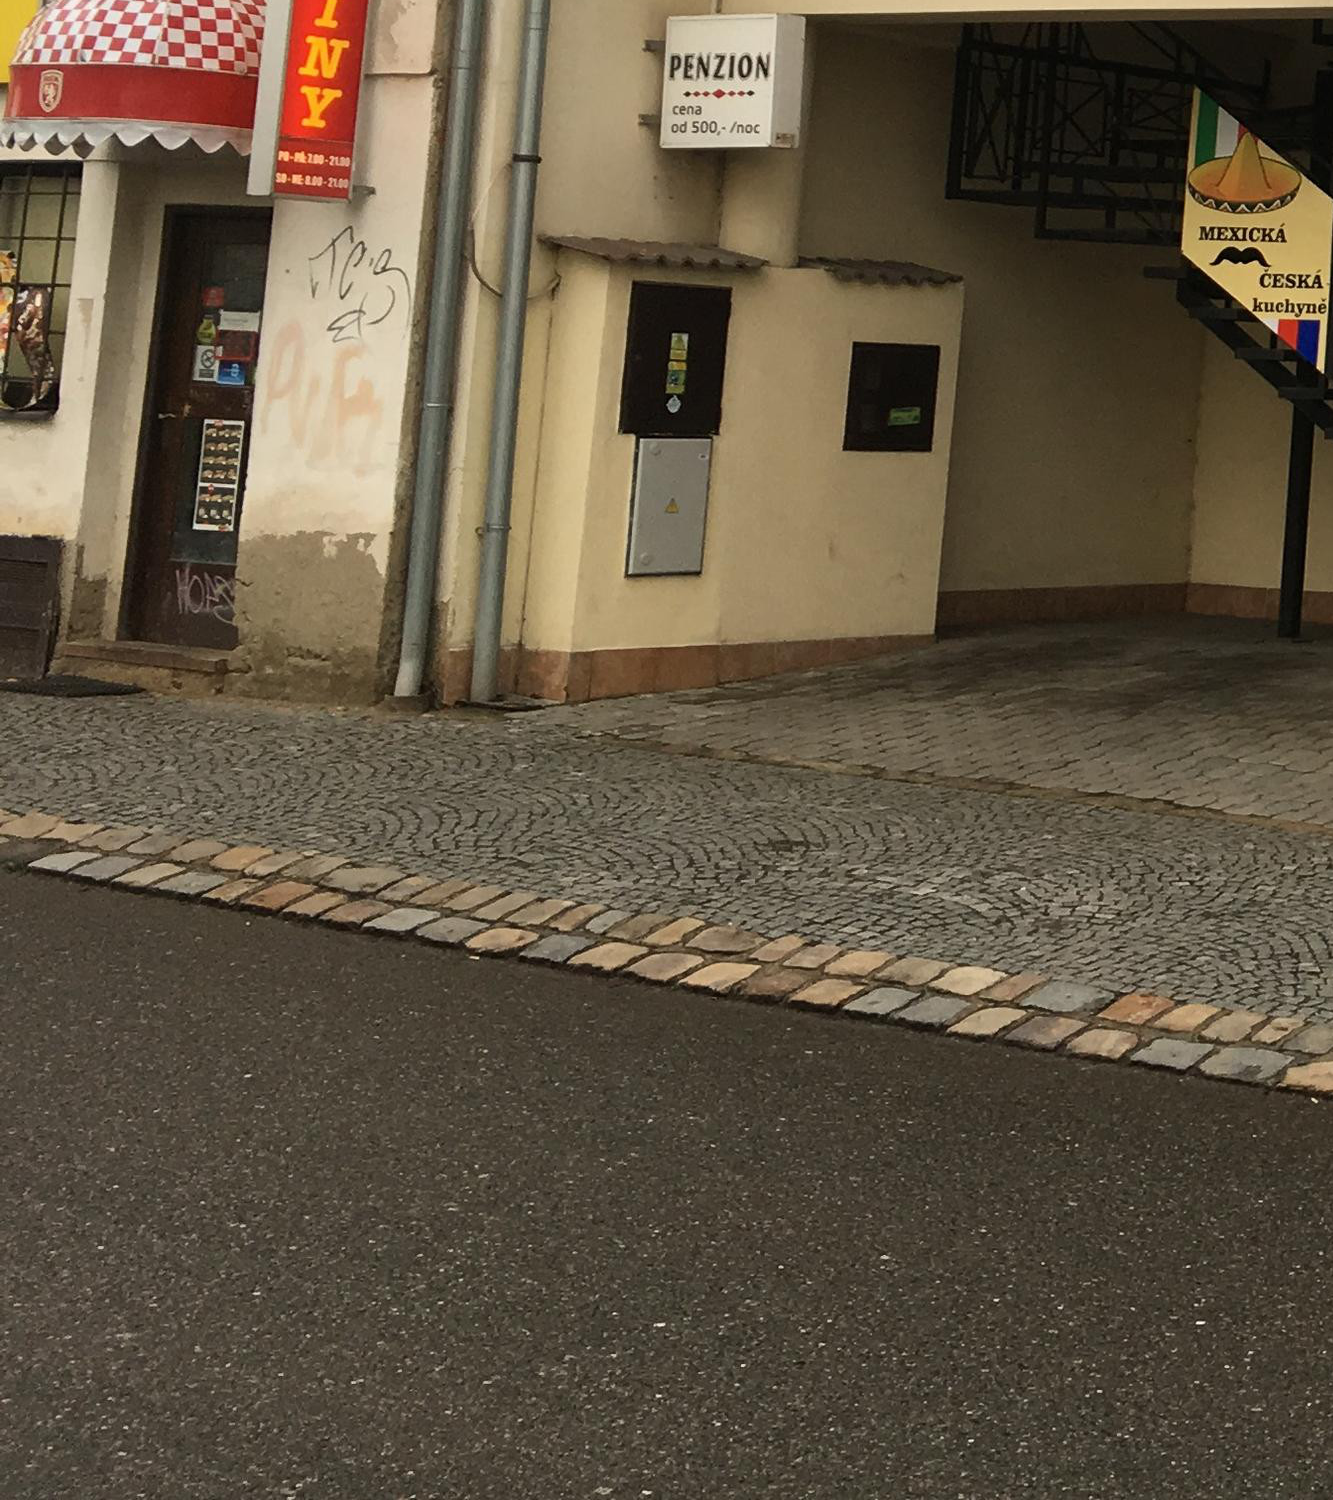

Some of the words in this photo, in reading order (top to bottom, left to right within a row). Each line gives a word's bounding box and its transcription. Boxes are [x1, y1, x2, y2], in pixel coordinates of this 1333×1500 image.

[669, 52, 771, 80] PENZION
[672, 105, 702, 115] cena
[671, 121, 687, 133] od
[1198, 223, 1287, 243] MEXICKÁ
[1259, 269, 1324, 289] ČESKÁ
[1252, 298, 1327, 318] kuchyně
